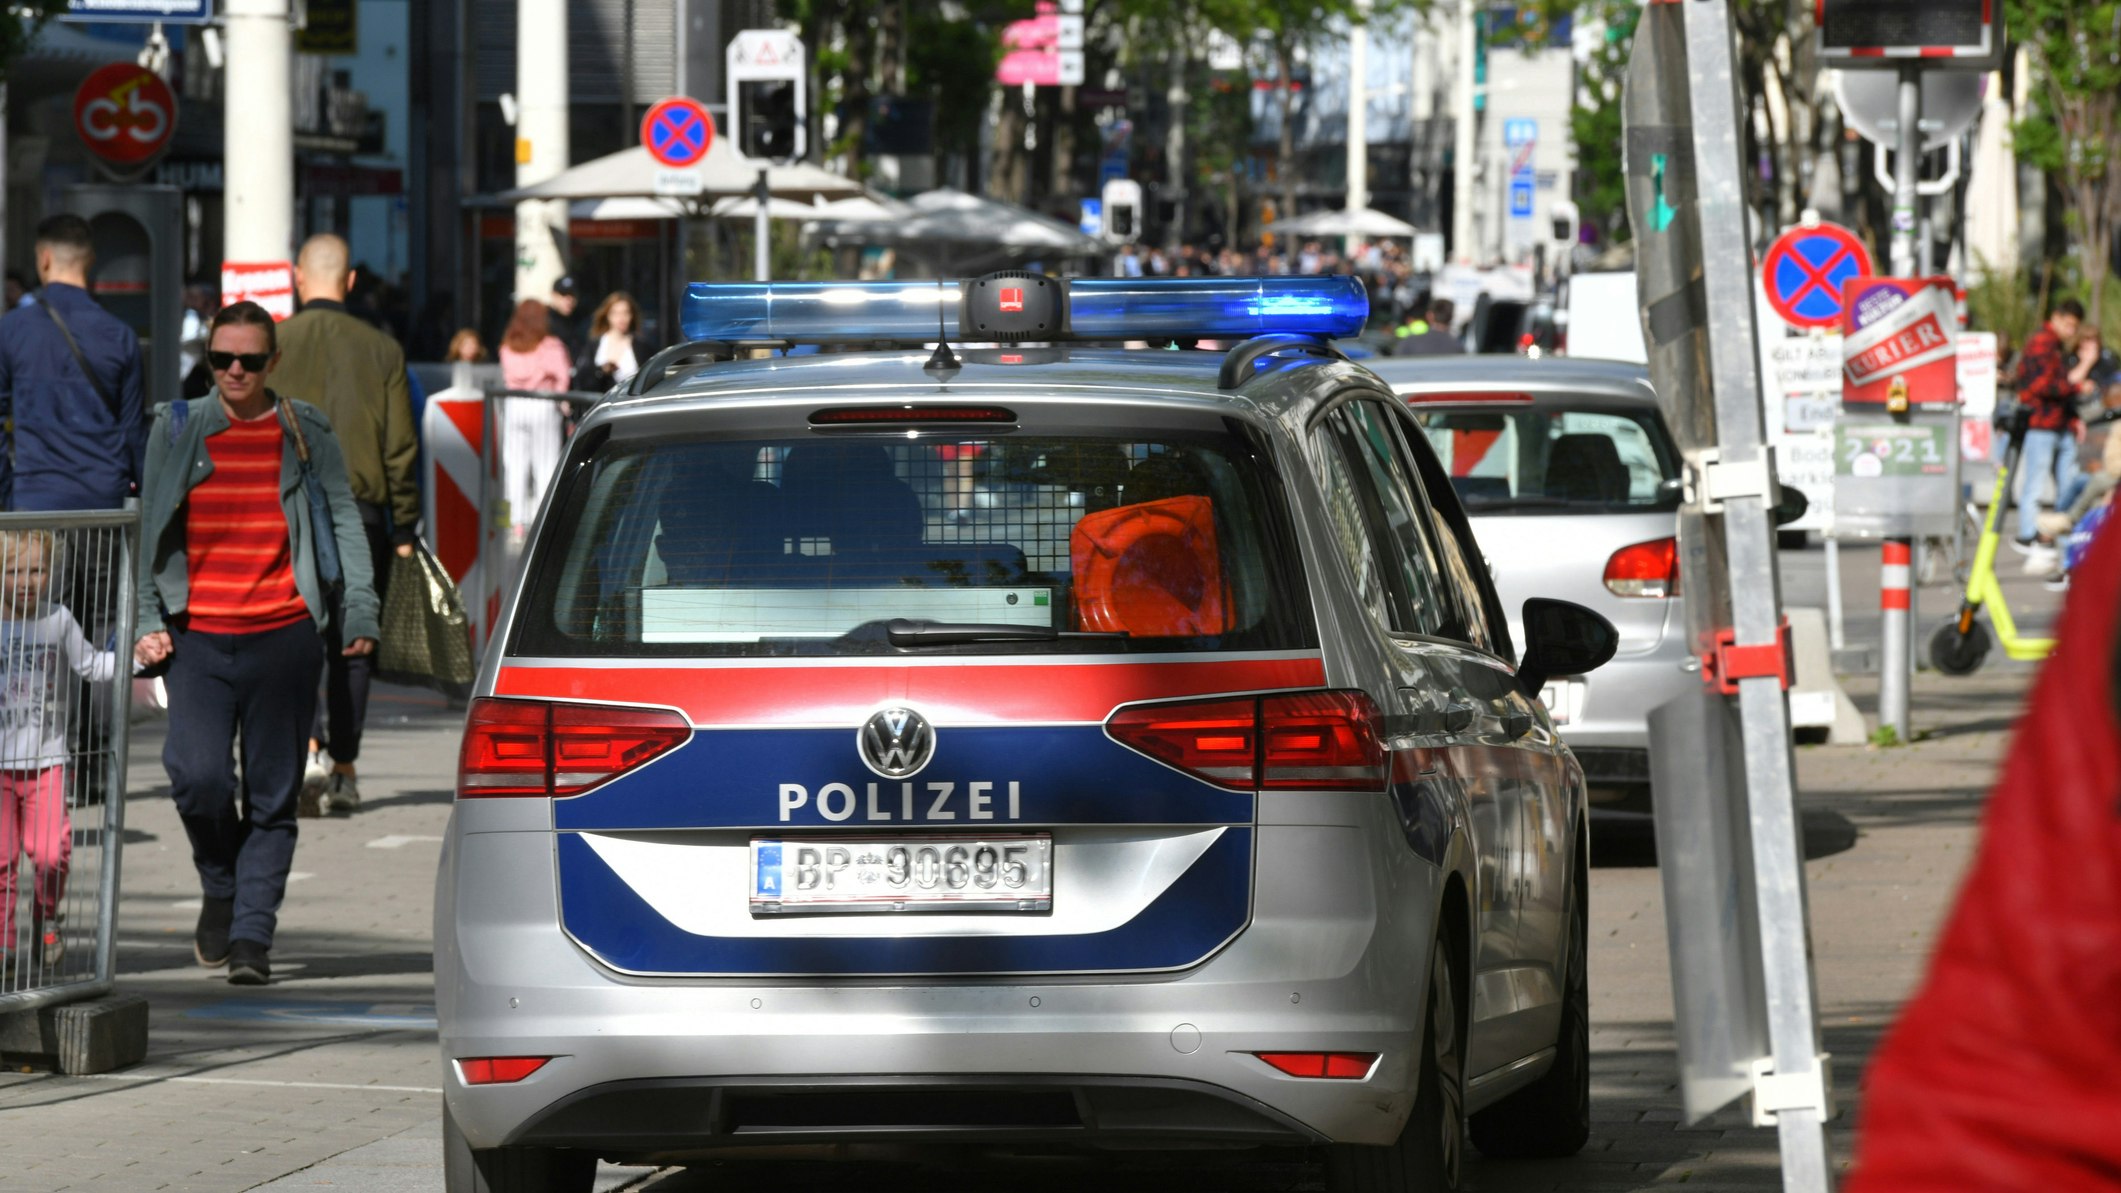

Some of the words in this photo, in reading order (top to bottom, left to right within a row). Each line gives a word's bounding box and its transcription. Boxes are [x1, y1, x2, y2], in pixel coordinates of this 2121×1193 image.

[1851, 322, 1942, 378] KURIER
[779, 781, 1020, 821] POLIZEI
[763, 877, 776, 890] A
[797, 847, 850, 890] BP
[887, 845, 1028, 889] 90695
